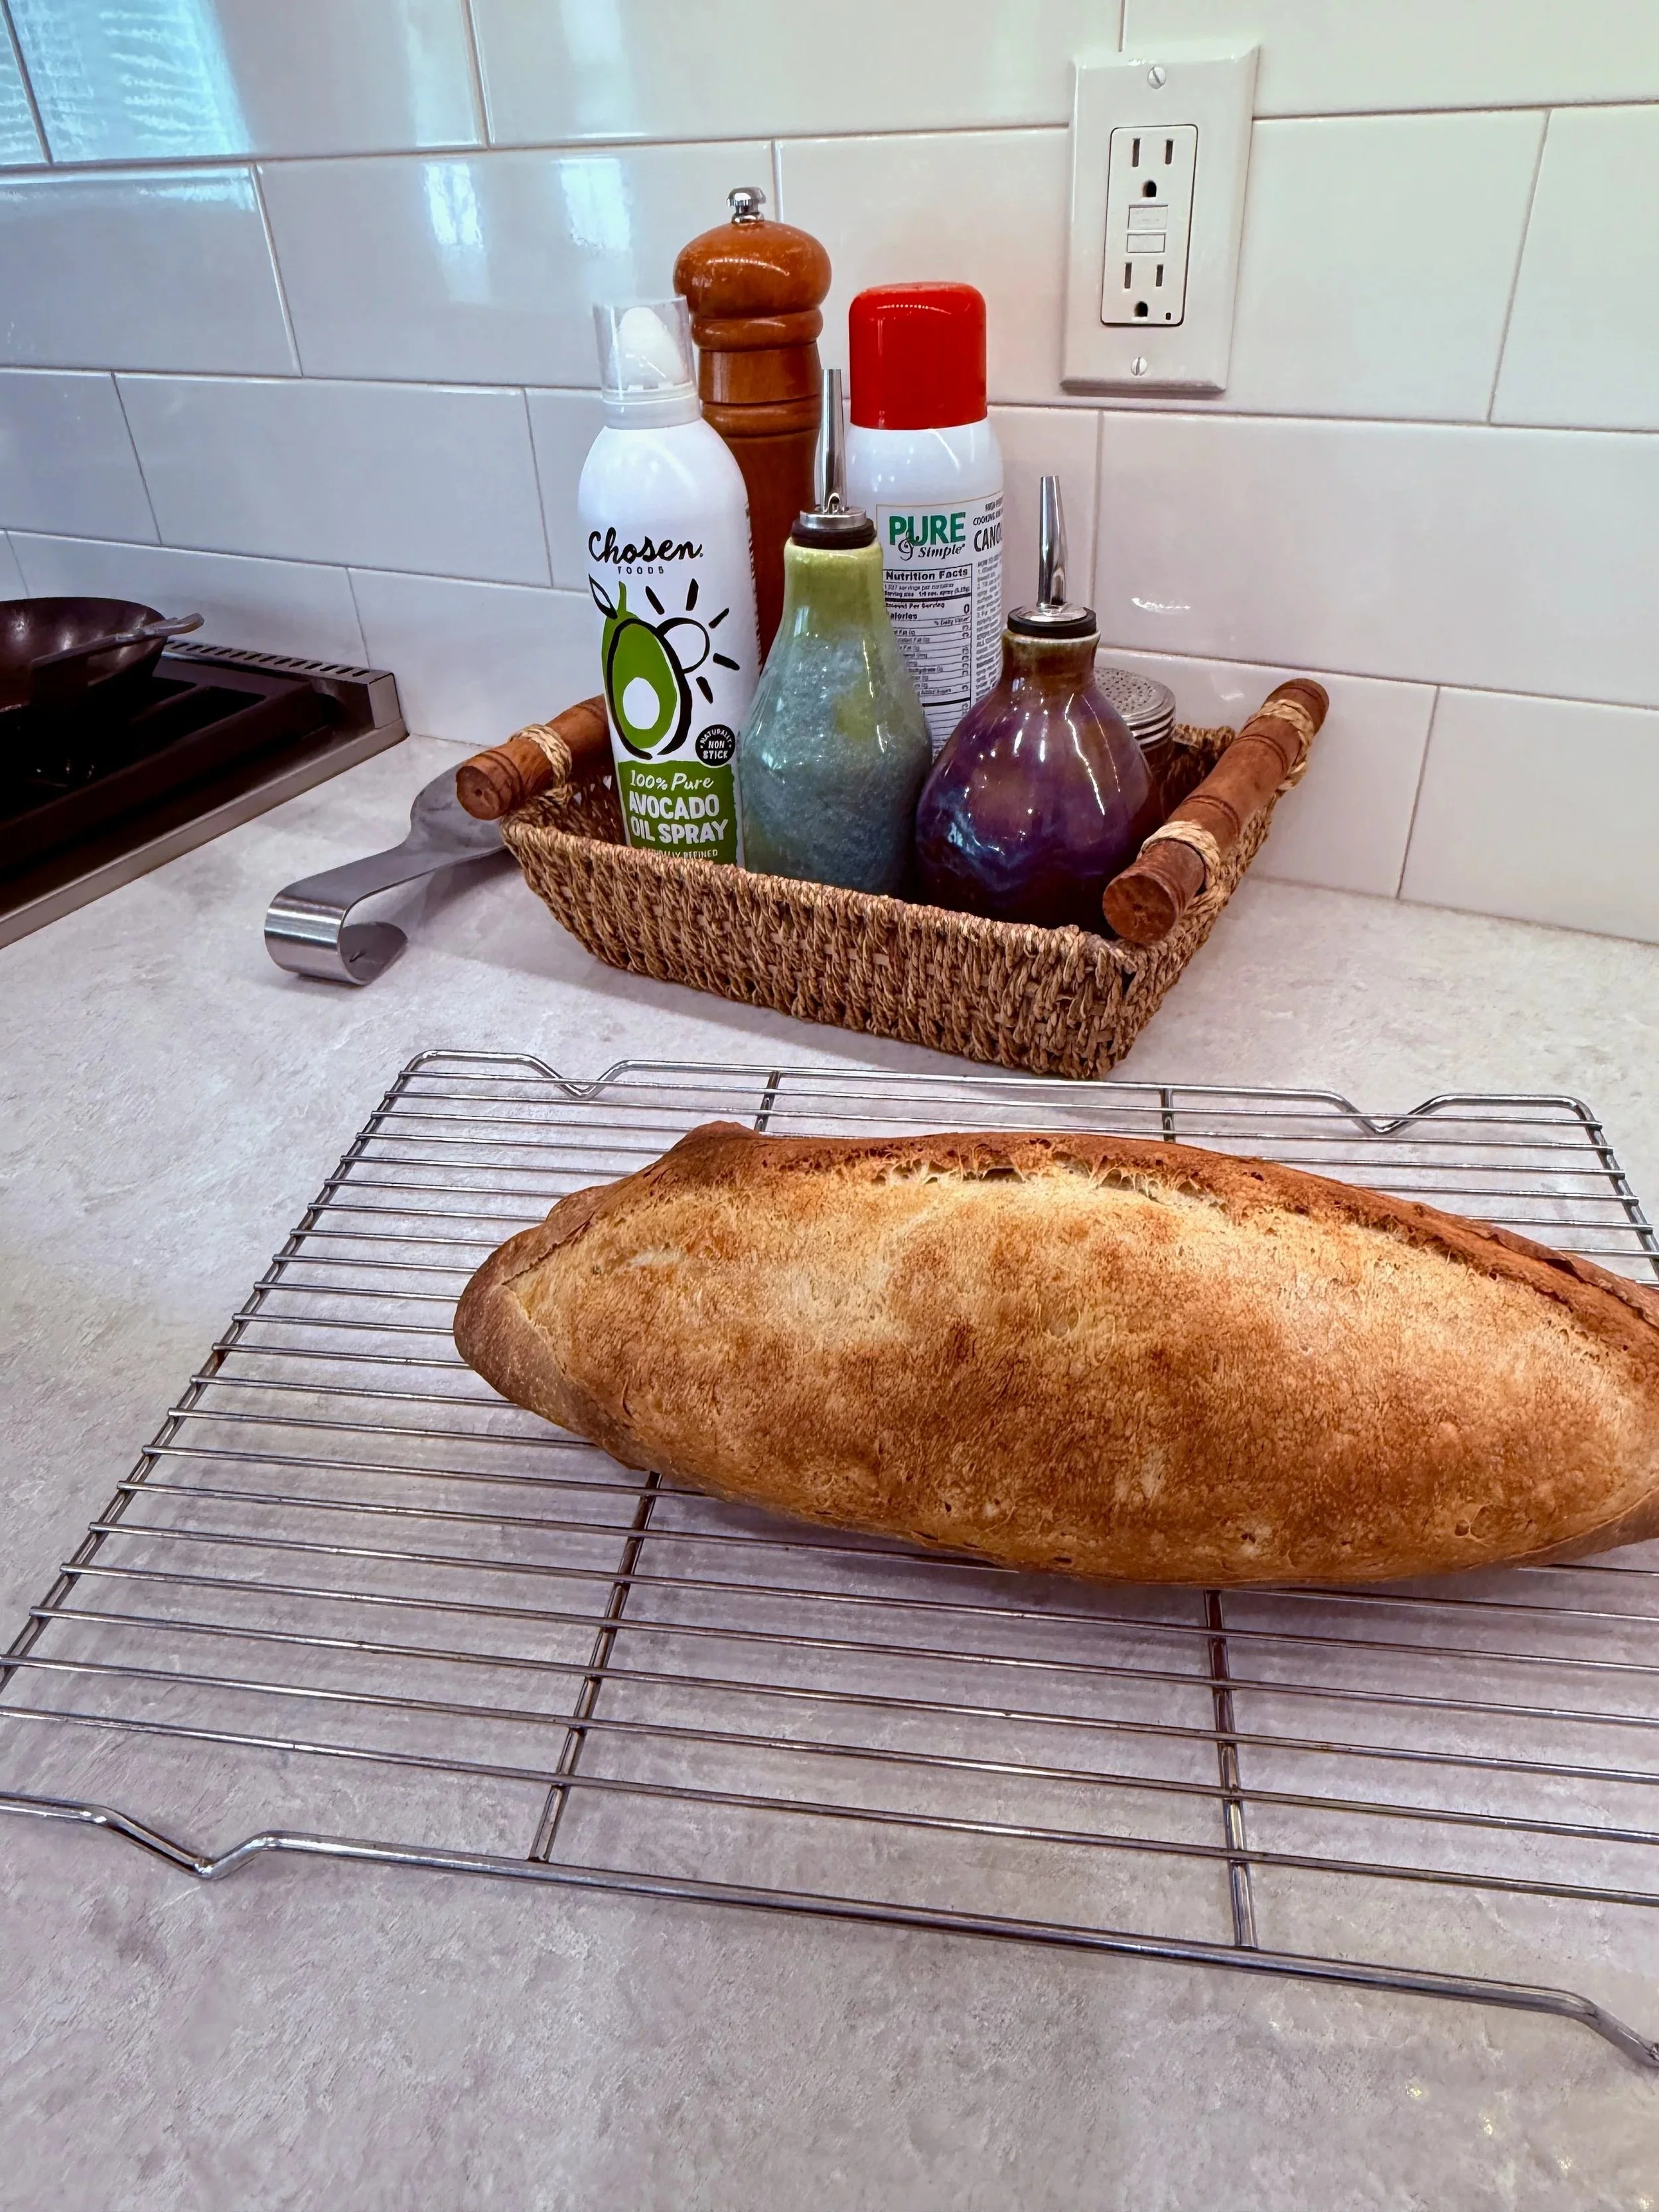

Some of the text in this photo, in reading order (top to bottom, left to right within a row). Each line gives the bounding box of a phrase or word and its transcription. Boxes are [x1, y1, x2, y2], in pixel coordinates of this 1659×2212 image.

[889, 512, 966, 546] PURE
[974, 522, 1003, 552] CANO
[589, 527, 703, 565] Chosen
[918, 544, 964, 560] Simple
[617, 566, 664, 575] FOODS
[886, 569, 968, 581] Nutrition Facts
[964, 603, 970, 614] 0
[700, 728, 733, 745] NATURALLY
[708, 740, 725, 749] NON
[703, 750, 728, 759] STICK
[630, 770, 714, 791] 100% Pure
[629, 790, 719, 820] AVOCADO
[630, 816, 729, 844] OIL SPRAY
